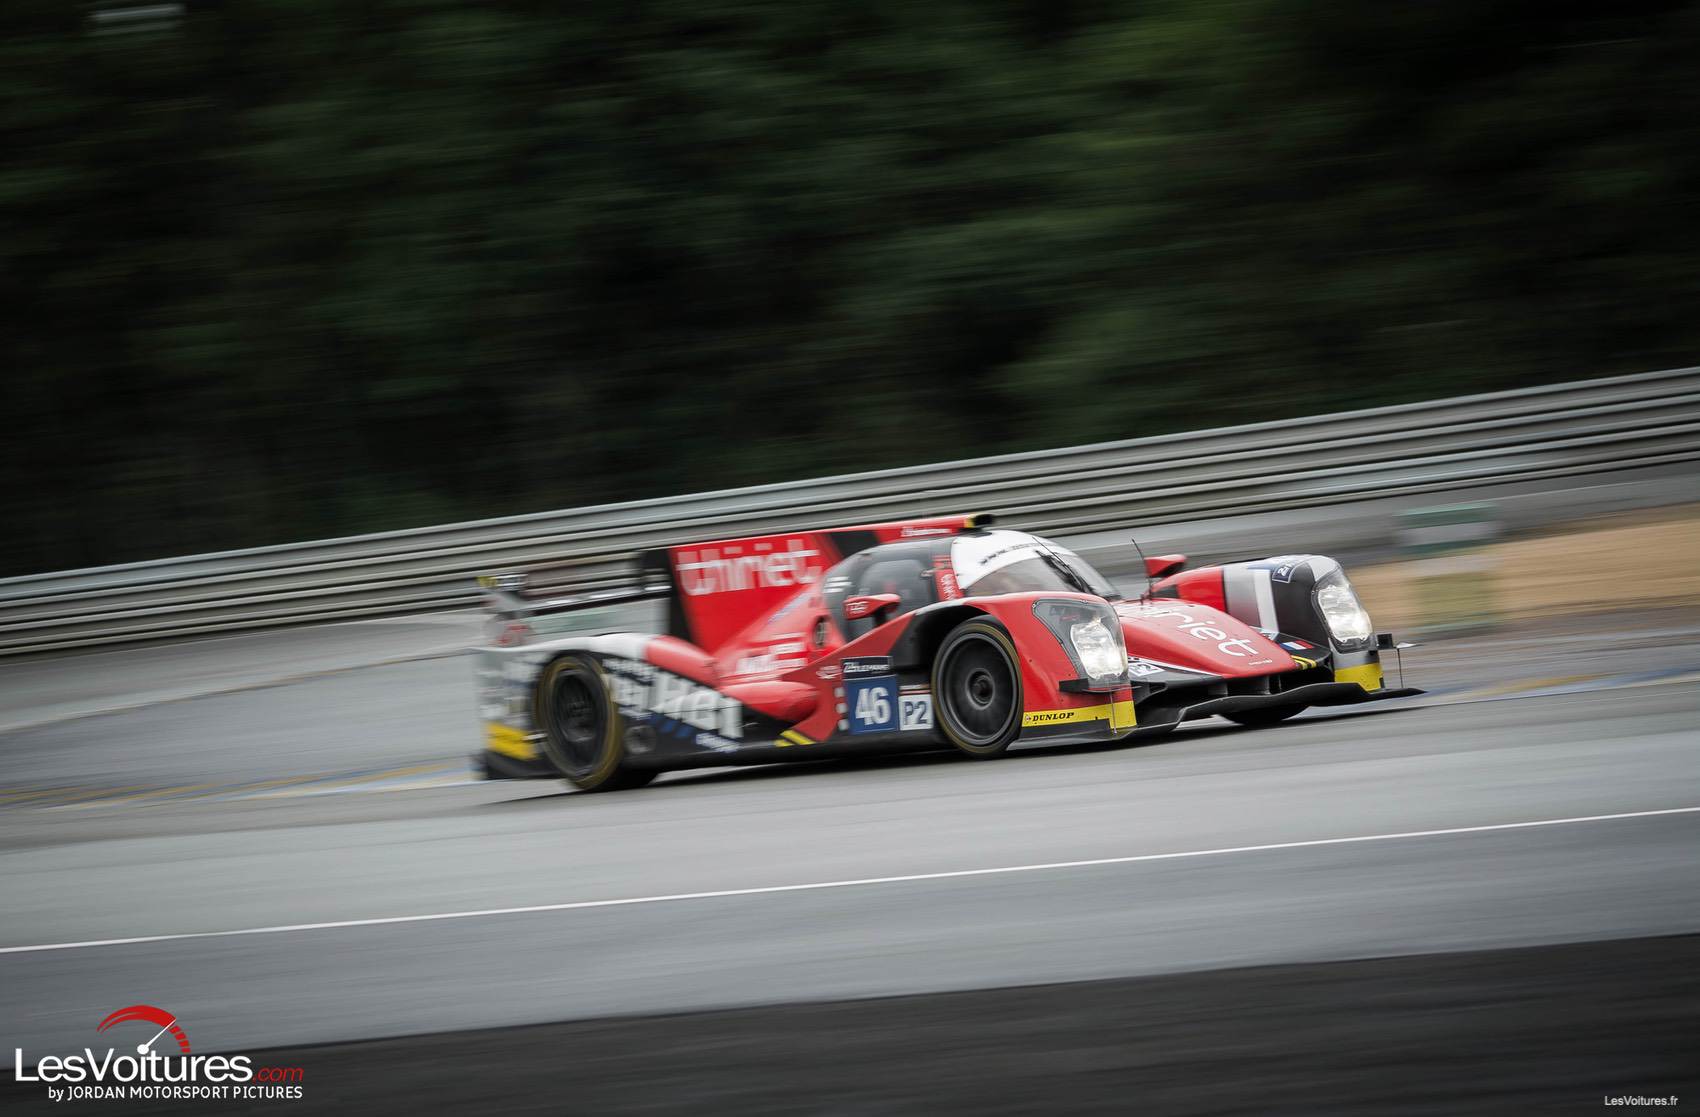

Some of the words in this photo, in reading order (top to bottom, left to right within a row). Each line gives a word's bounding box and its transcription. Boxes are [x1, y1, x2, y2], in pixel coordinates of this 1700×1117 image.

[855, 687, 891, 725] 46
[903, 701, 928, 725] P2
[1032, 712, 1075, 721] DUNLOP
